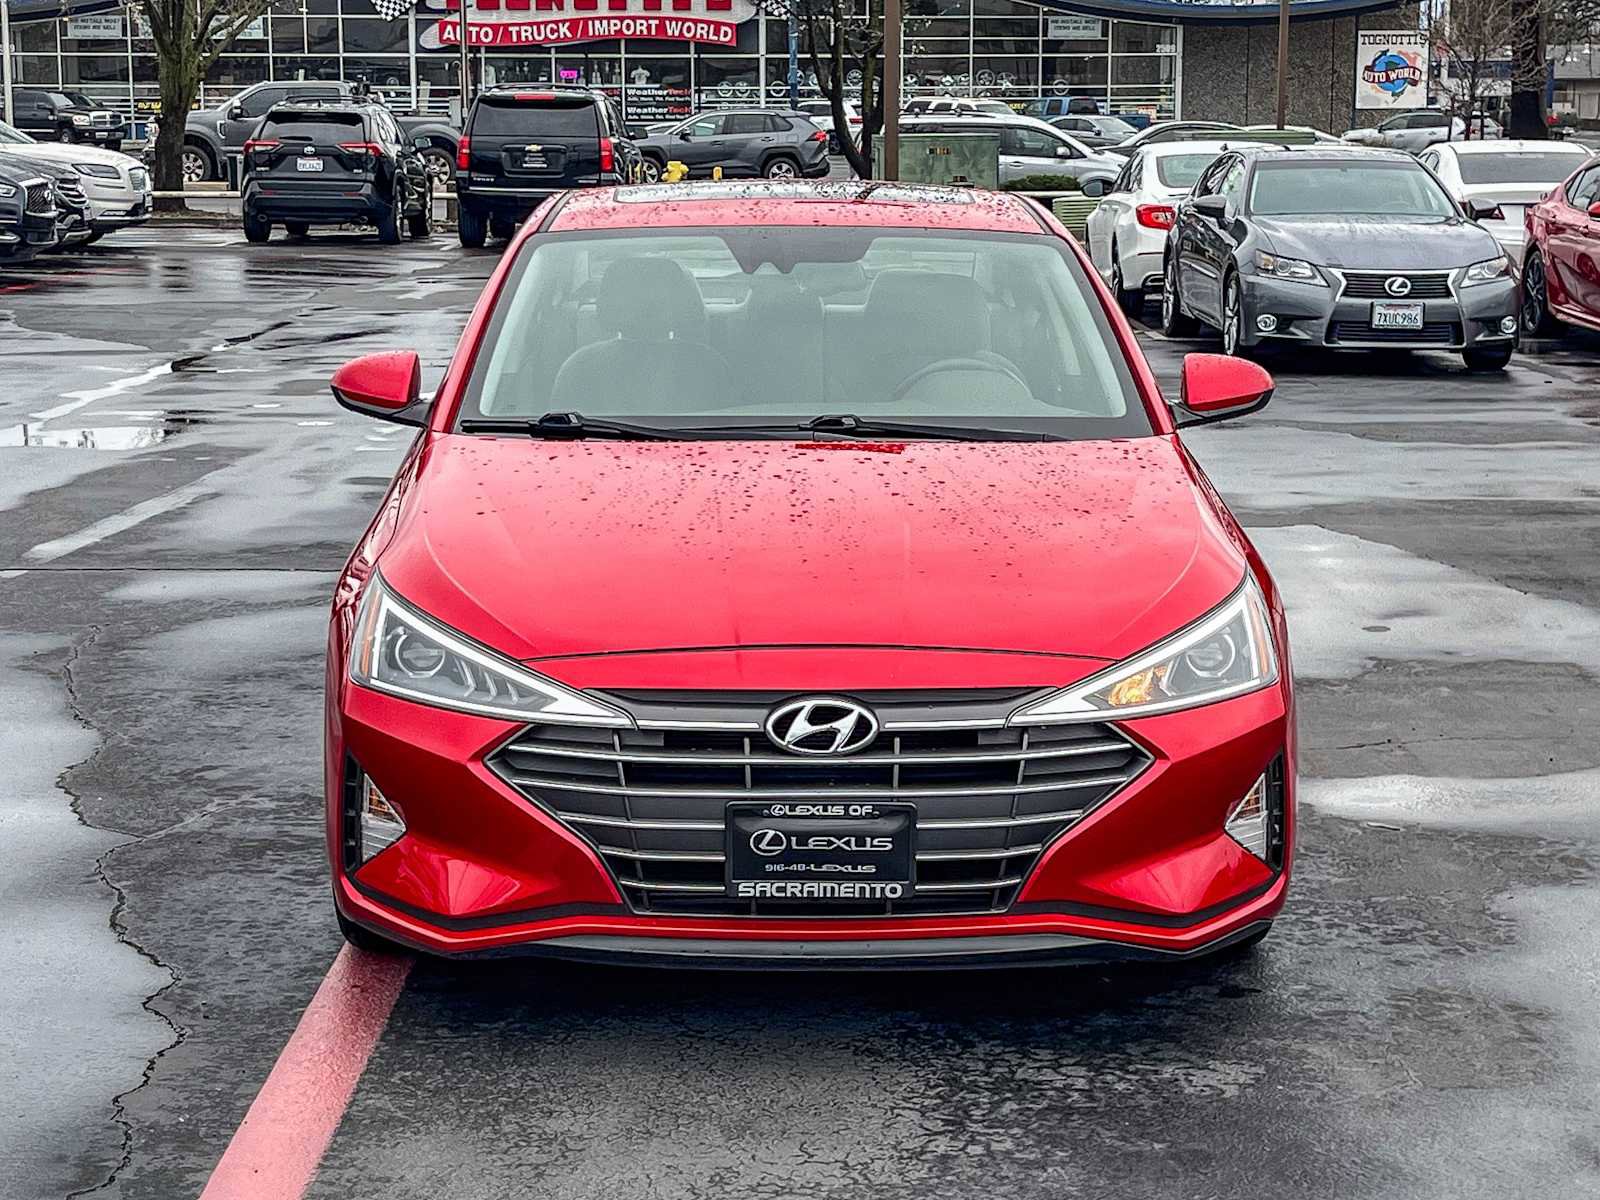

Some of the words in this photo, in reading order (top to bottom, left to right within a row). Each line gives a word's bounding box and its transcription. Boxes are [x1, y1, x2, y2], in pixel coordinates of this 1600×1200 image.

[508, 22, 573, 43] TRUCK
[588, 19, 660, 37] IMPORT
[665, 20, 732, 42] WORLD
[1388, 68, 1420, 81] WORLD
[784, 805, 845, 816] LEXUS
[848, 805, 874, 816] OF
[790, 836, 894, 852] LEXUS
[737, 882, 904, 899] SACRAMENTO
